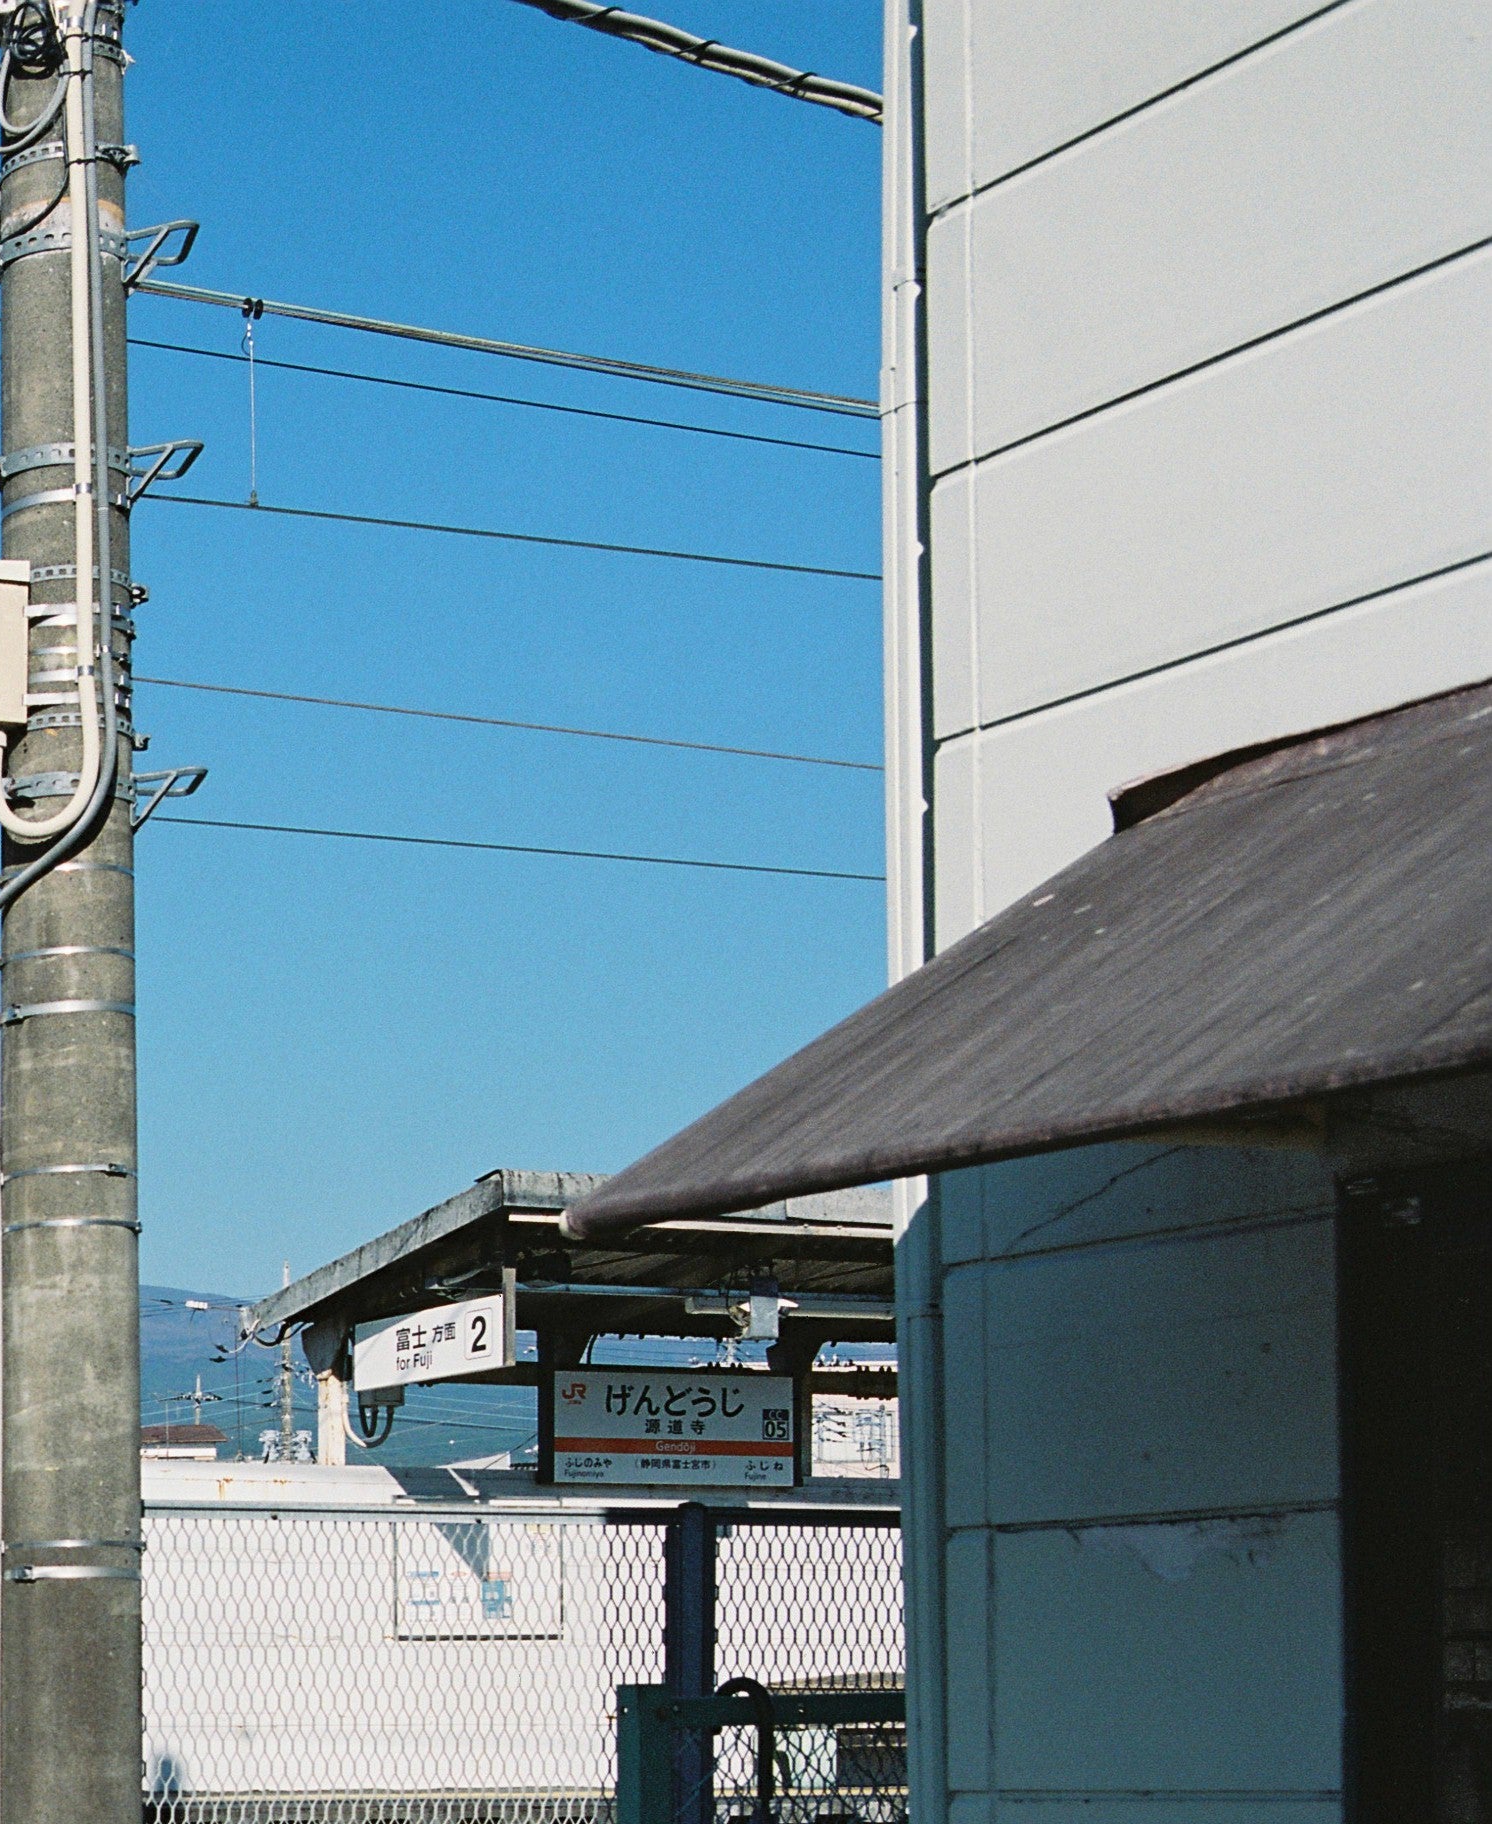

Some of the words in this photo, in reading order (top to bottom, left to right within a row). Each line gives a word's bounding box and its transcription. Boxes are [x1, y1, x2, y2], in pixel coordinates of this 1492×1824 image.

[471, 1315, 487, 1353] 2
[396, 1356, 410, 1371] for
[413, 1351, 433, 1370] Fuji
[561, 1383, 587, 1400] JR
[605, 1384, 745, 1418] げんどうじ
[768, 1409, 783, 1419] CC
[644, 1418, 706, 1435] 源道寺
[765, 1421, 788, 1438] 05
[564, 1457, 613, 1468] ふじのみや
[745, 1460, 784, 1471] ふじね
[564, 1469, 605, 1479] Fujinomiya
[744, 1472, 767, 1481] Fujine
